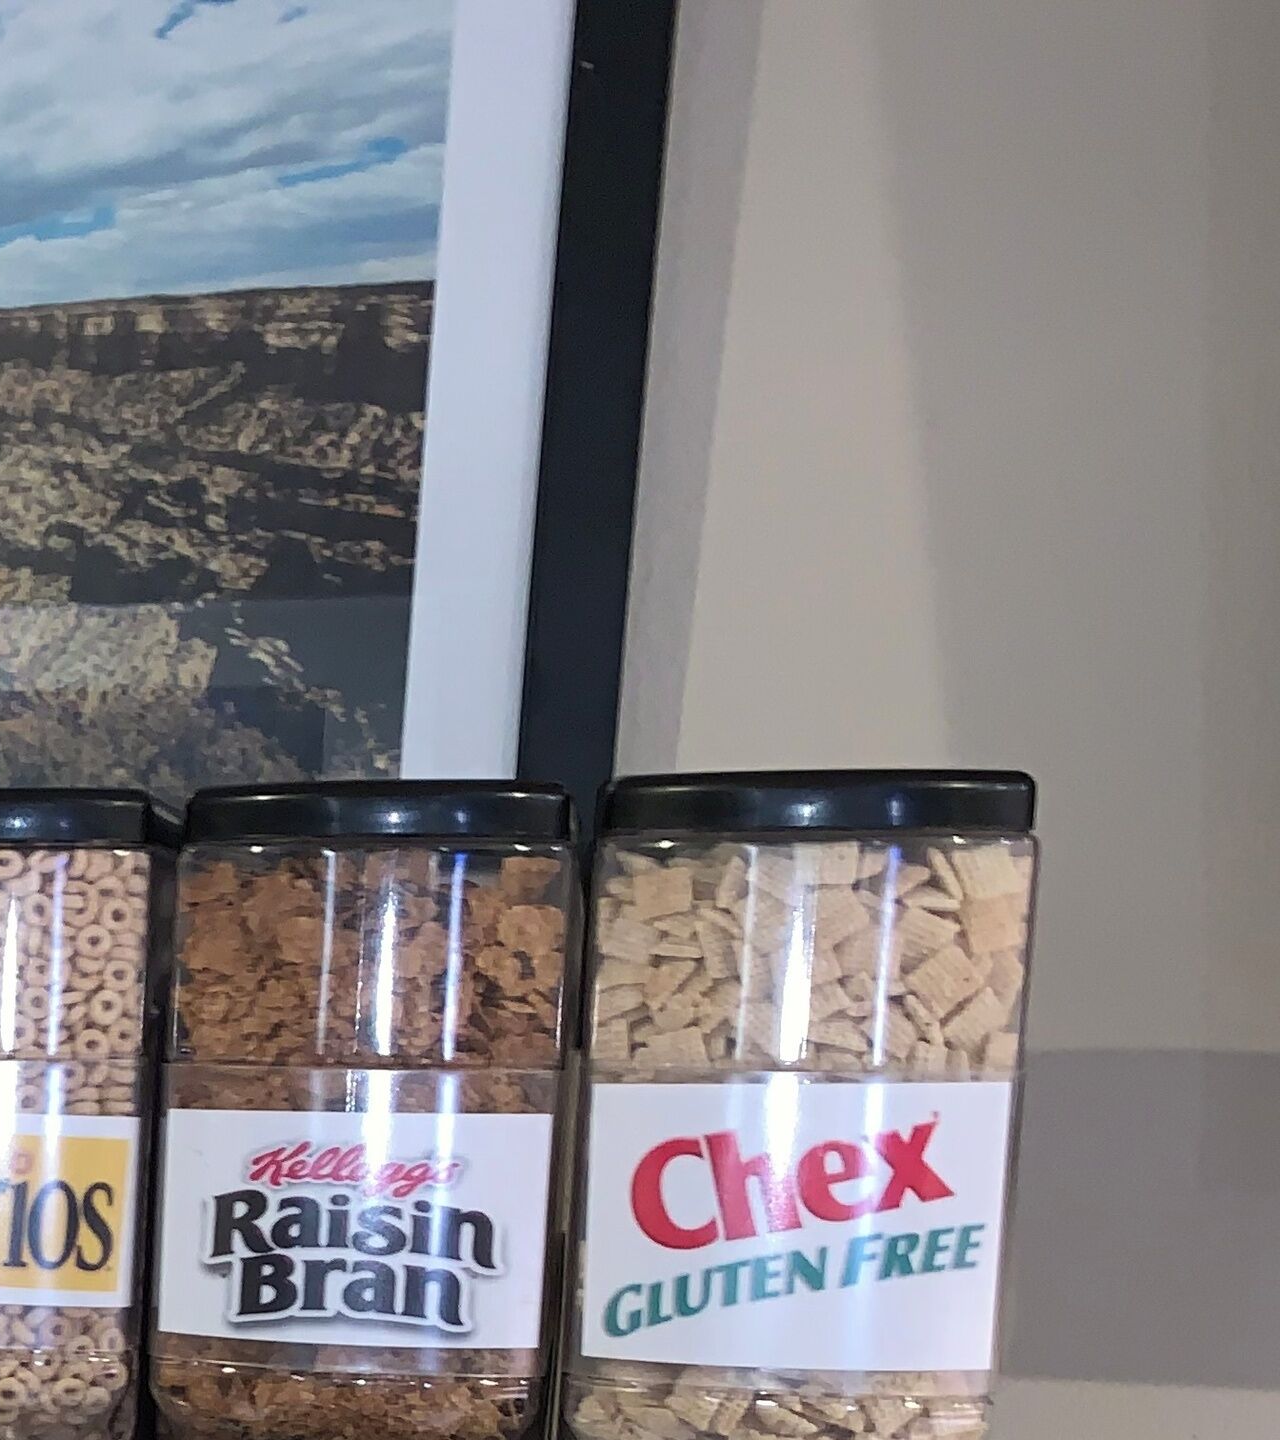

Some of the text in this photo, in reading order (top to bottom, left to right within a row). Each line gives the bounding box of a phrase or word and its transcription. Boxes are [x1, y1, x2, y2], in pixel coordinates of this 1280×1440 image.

[210, 1190, 497, 1269] Raisin
[629, 1118, 958, 1251] Chex
[237, 1253, 464, 1325] Bran
[603, 1223, 986, 1339] GLUTEN FREE
